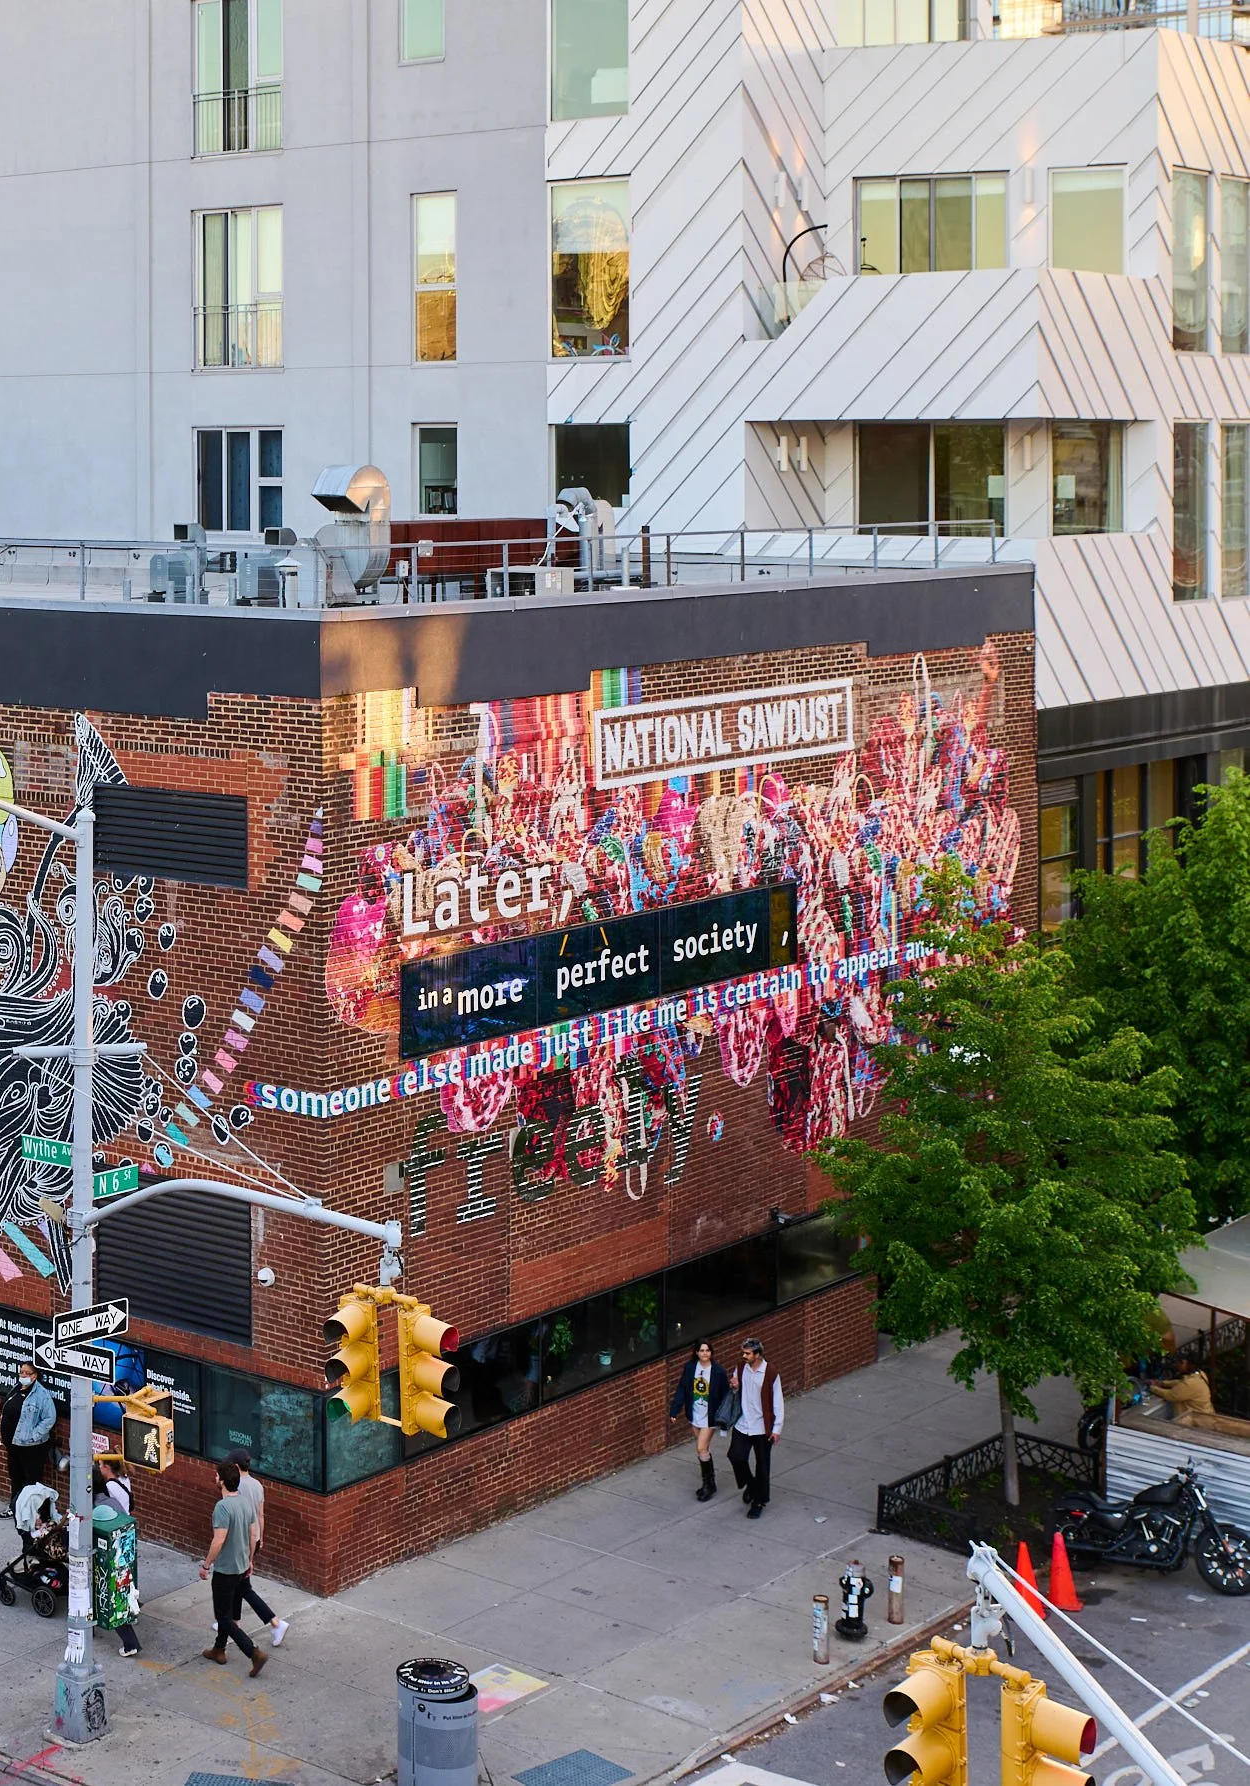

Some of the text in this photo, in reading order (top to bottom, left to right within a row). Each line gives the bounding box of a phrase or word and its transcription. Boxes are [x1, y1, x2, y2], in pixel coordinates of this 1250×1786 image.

[604, 693, 842, 771] NATIONAL SAWDUST
[403, 863, 575, 937] Later,
[417, 986, 437, 1011] in
[442, 989, 452, 1005] a
[457, 977, 523, 1015] more
[556, 944, 650, 999] perfect
[673, 920, 758, 962] society
[261, 1079, 391, 1118] someone
[403, 1060, 462, 1096] else
[469, 1038, 534, 1079] made
[542, 1020, 593, 1068] just
[601, 1006, 650, 1043] like
[657, 999, 688, 1028] me
[695, 987, 718, 1016] is
[724, 968, 802, 1009] certain
[810, 959, 830, 985] to
[837, 944, 899, 984] appear
[23, 1137, 58, 1159] Wythe
[100, 1170, 132, 1194] N 6 St
[8, 1320, 34, 1336] National
[61, 1320, 82, 1336] ONE
[94, 1312, 118, 1328] WAY
[10, 1335, 32, 1350] believe
[44, 1347, 106, 1371] ONE WAY
[8, 1363, 16, 1373] all
[48, 1376, 53, 1384] a
[54, 1378, 71, 1390] more
[146, 1369, 174, 1386] Discover
[170, 1387, 192, 1402] inside.
